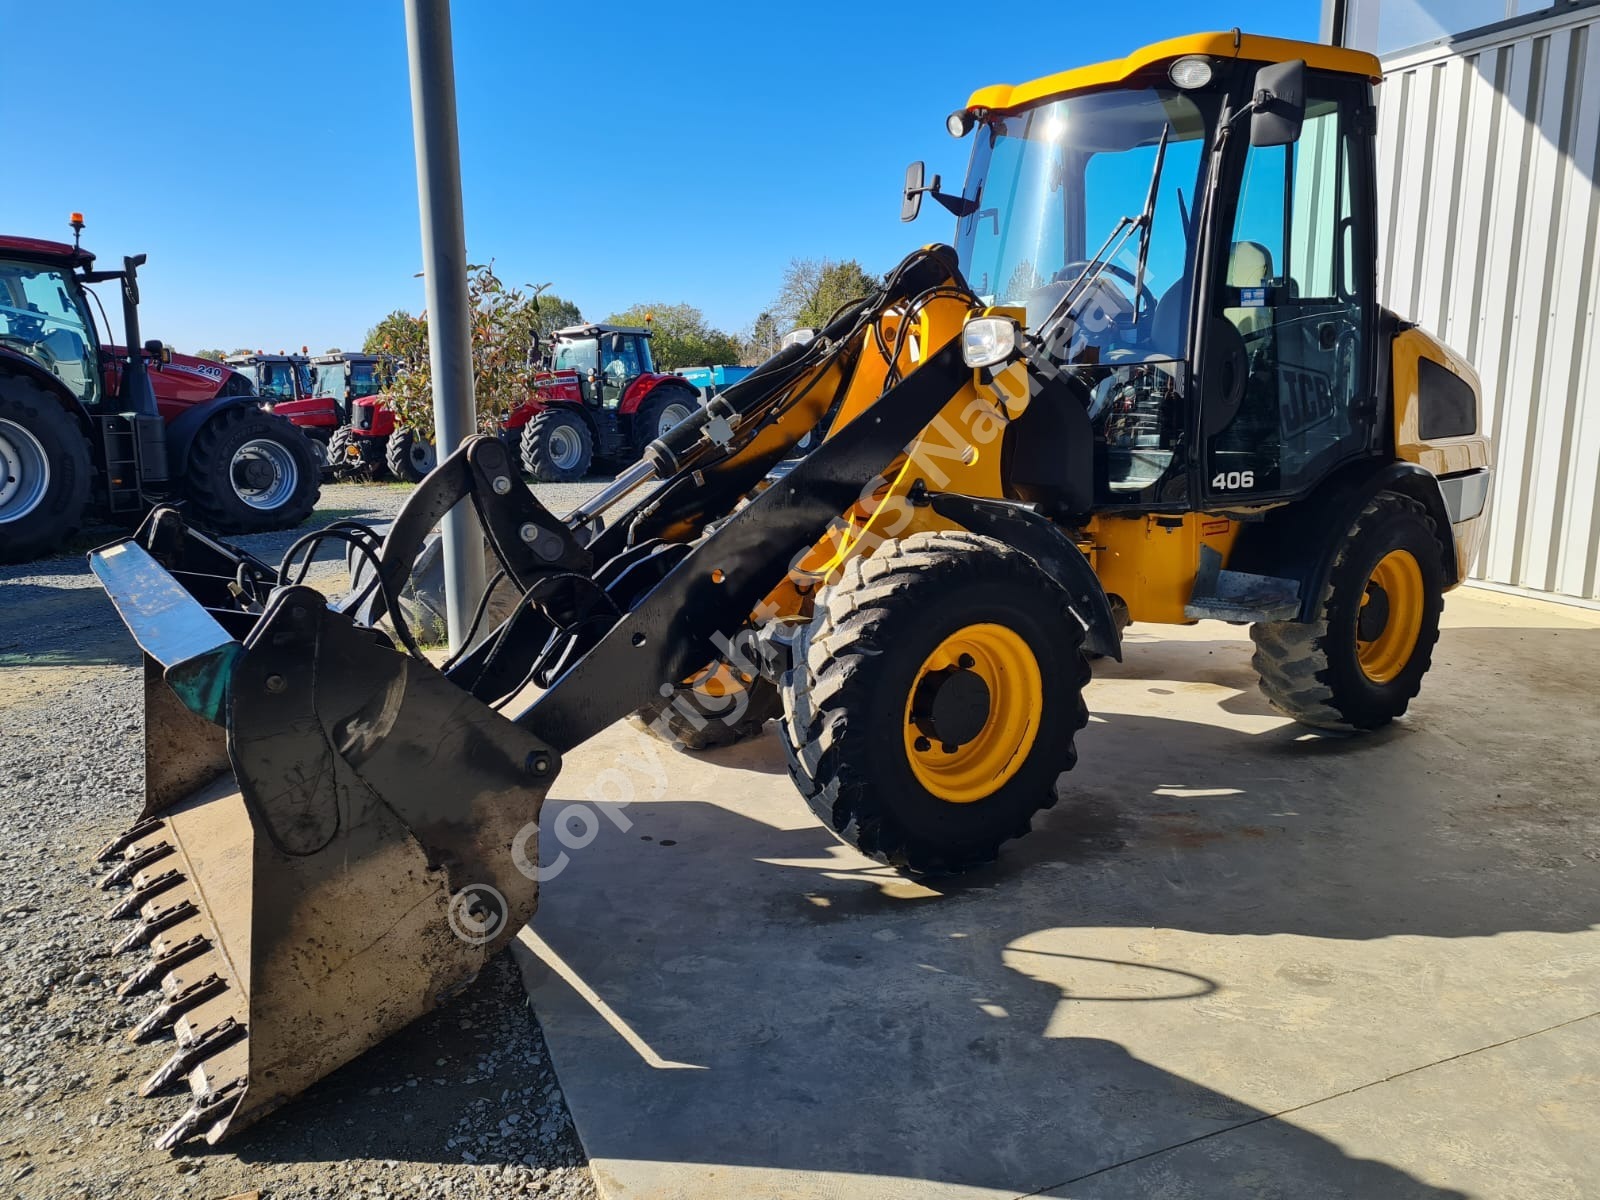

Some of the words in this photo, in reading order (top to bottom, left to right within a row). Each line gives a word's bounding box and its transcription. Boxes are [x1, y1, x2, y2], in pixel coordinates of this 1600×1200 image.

[198, 365, 221, 377] 240
[1282, 370, 1331, 431] JCB
[1212, 471, 1254, 490] 406
